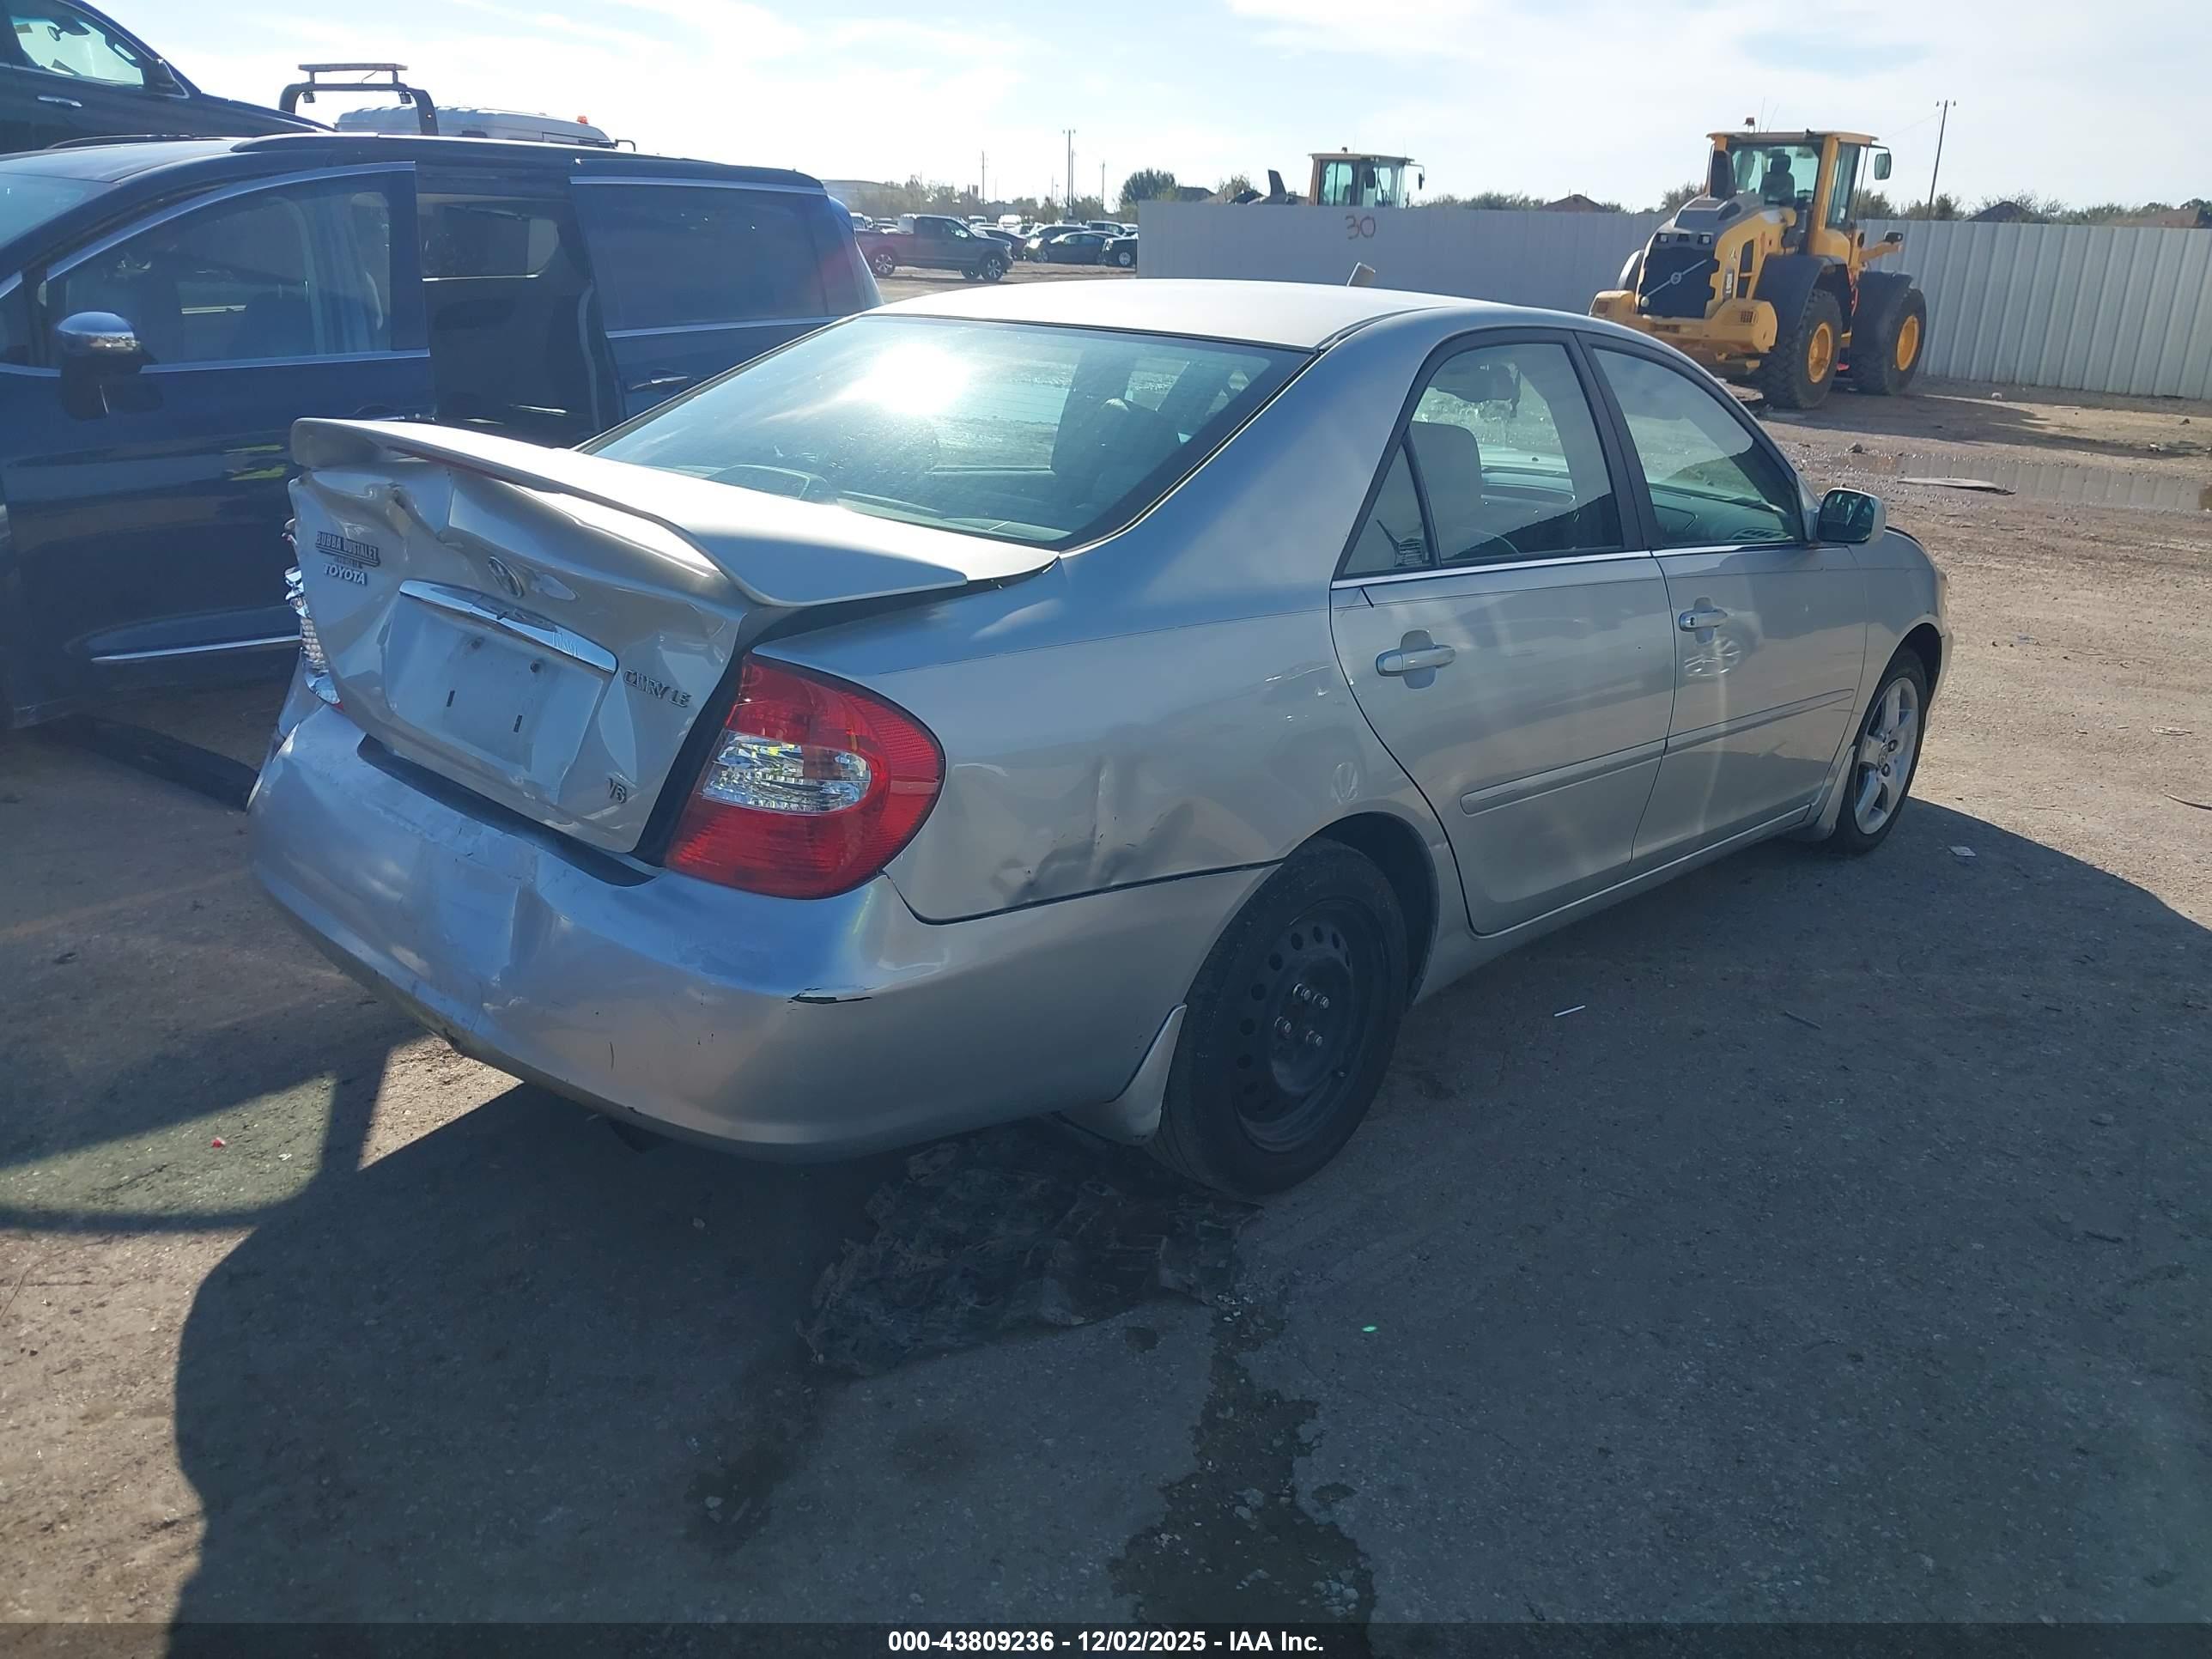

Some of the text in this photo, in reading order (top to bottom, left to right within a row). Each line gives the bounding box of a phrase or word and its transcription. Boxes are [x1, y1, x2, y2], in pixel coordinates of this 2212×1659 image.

[1345, 215, 1376, 240] 30
[316, 531, 342, 549] BUBBA
[323, 563, 366, 585] TOYOTA
[668, 689, 692, 708] LE
[605, 777, 627, 805] V6
